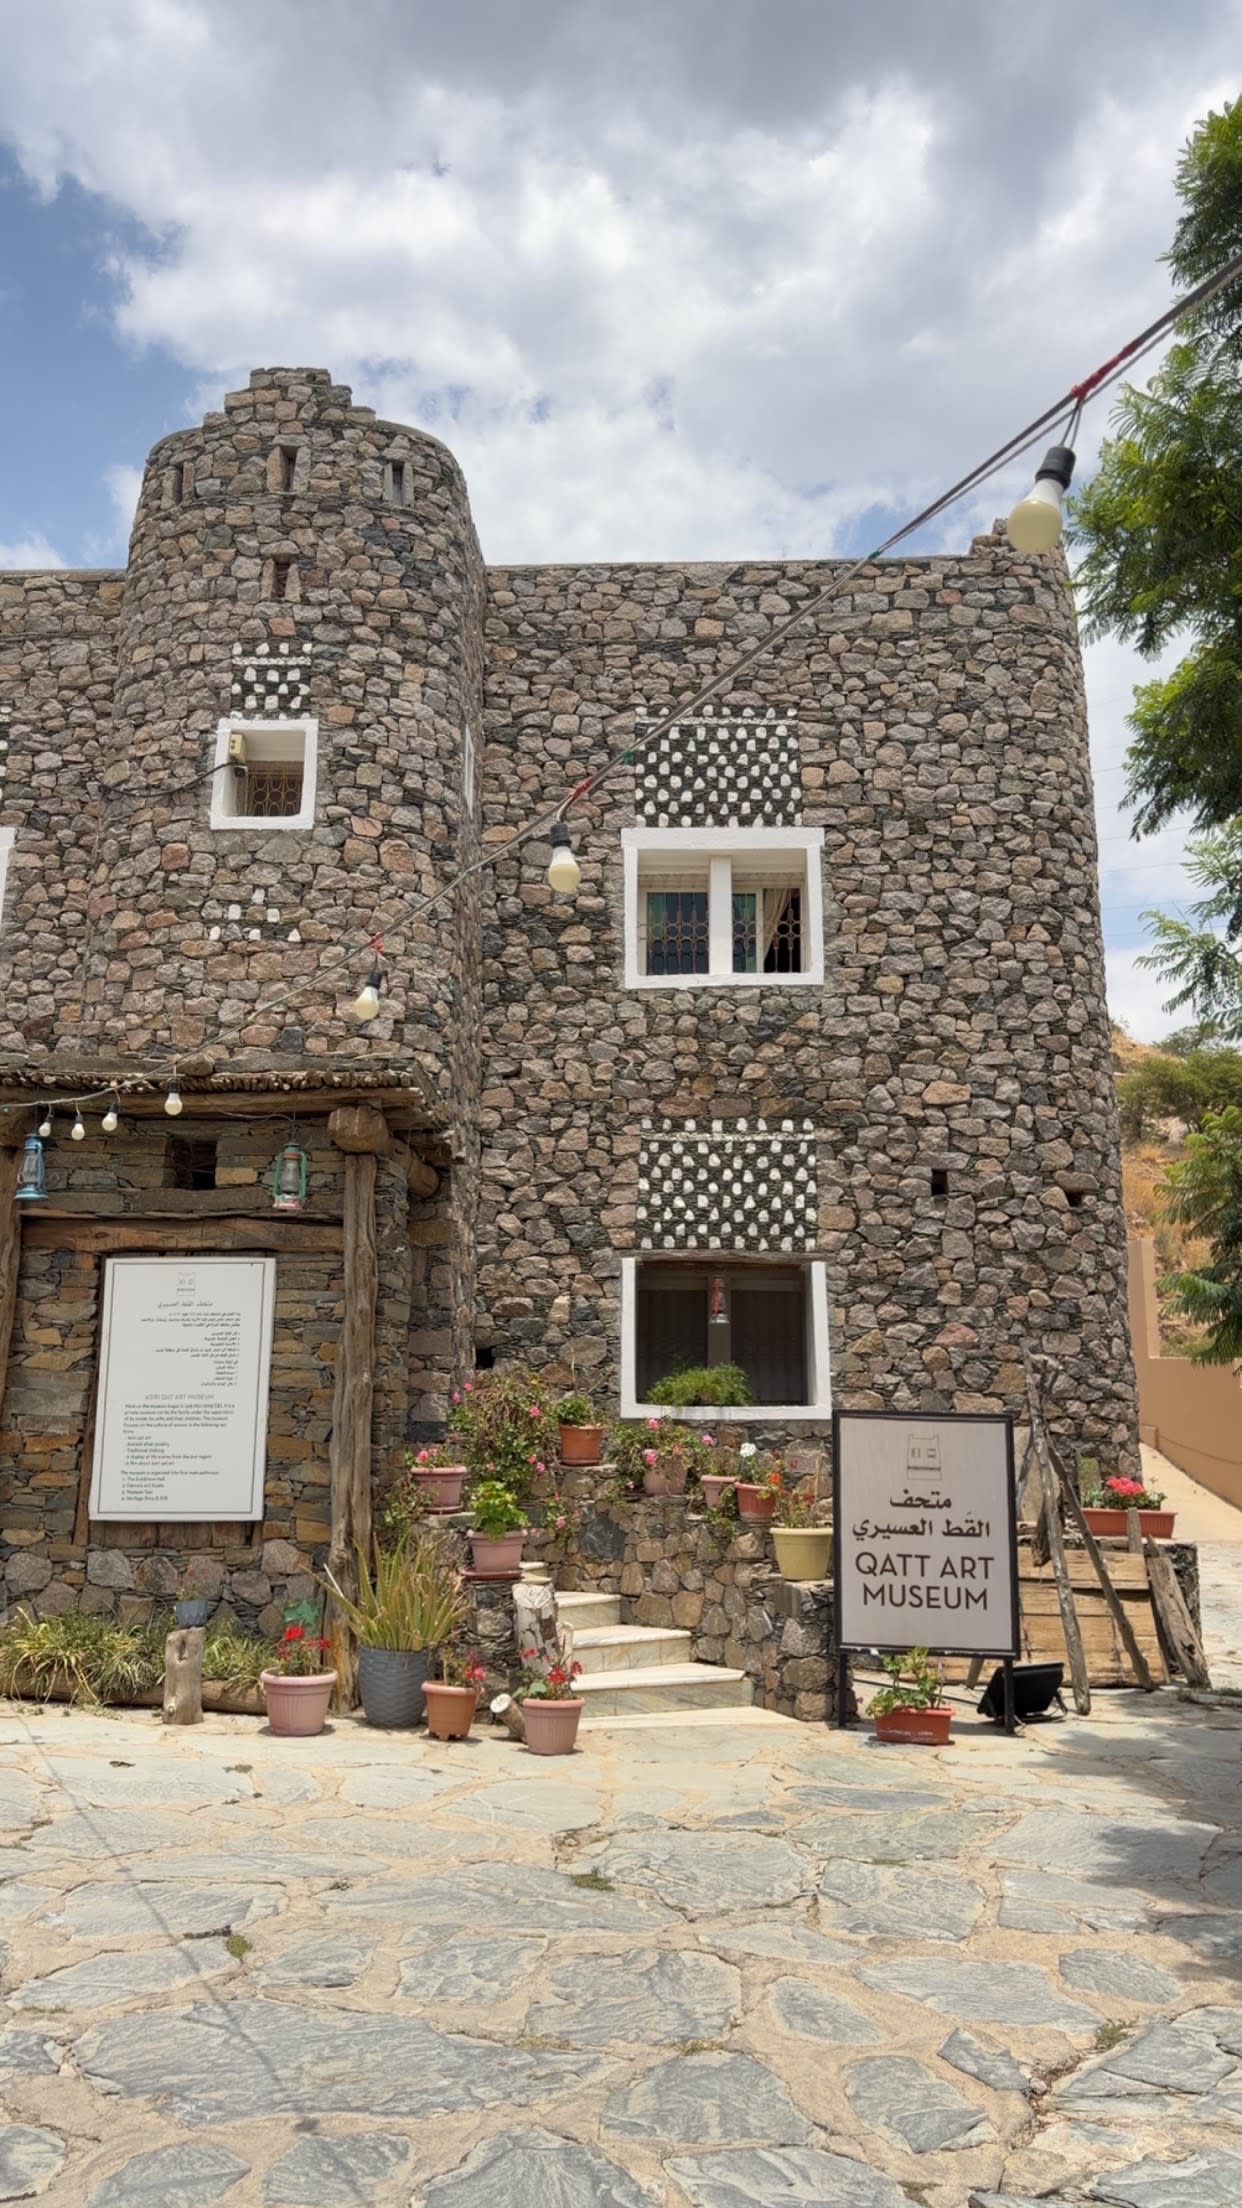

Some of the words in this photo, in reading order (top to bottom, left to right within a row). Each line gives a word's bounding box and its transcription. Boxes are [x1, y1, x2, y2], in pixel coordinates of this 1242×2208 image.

[889, 1488, 952, 1509] متحف
[852, 1518, 933, 1541] العسيري
[855, 1551, 931, 1578] QATT
[939, 1556, 995, 1580] ART
[863, 1583, 988, 1610] MUSEUM
